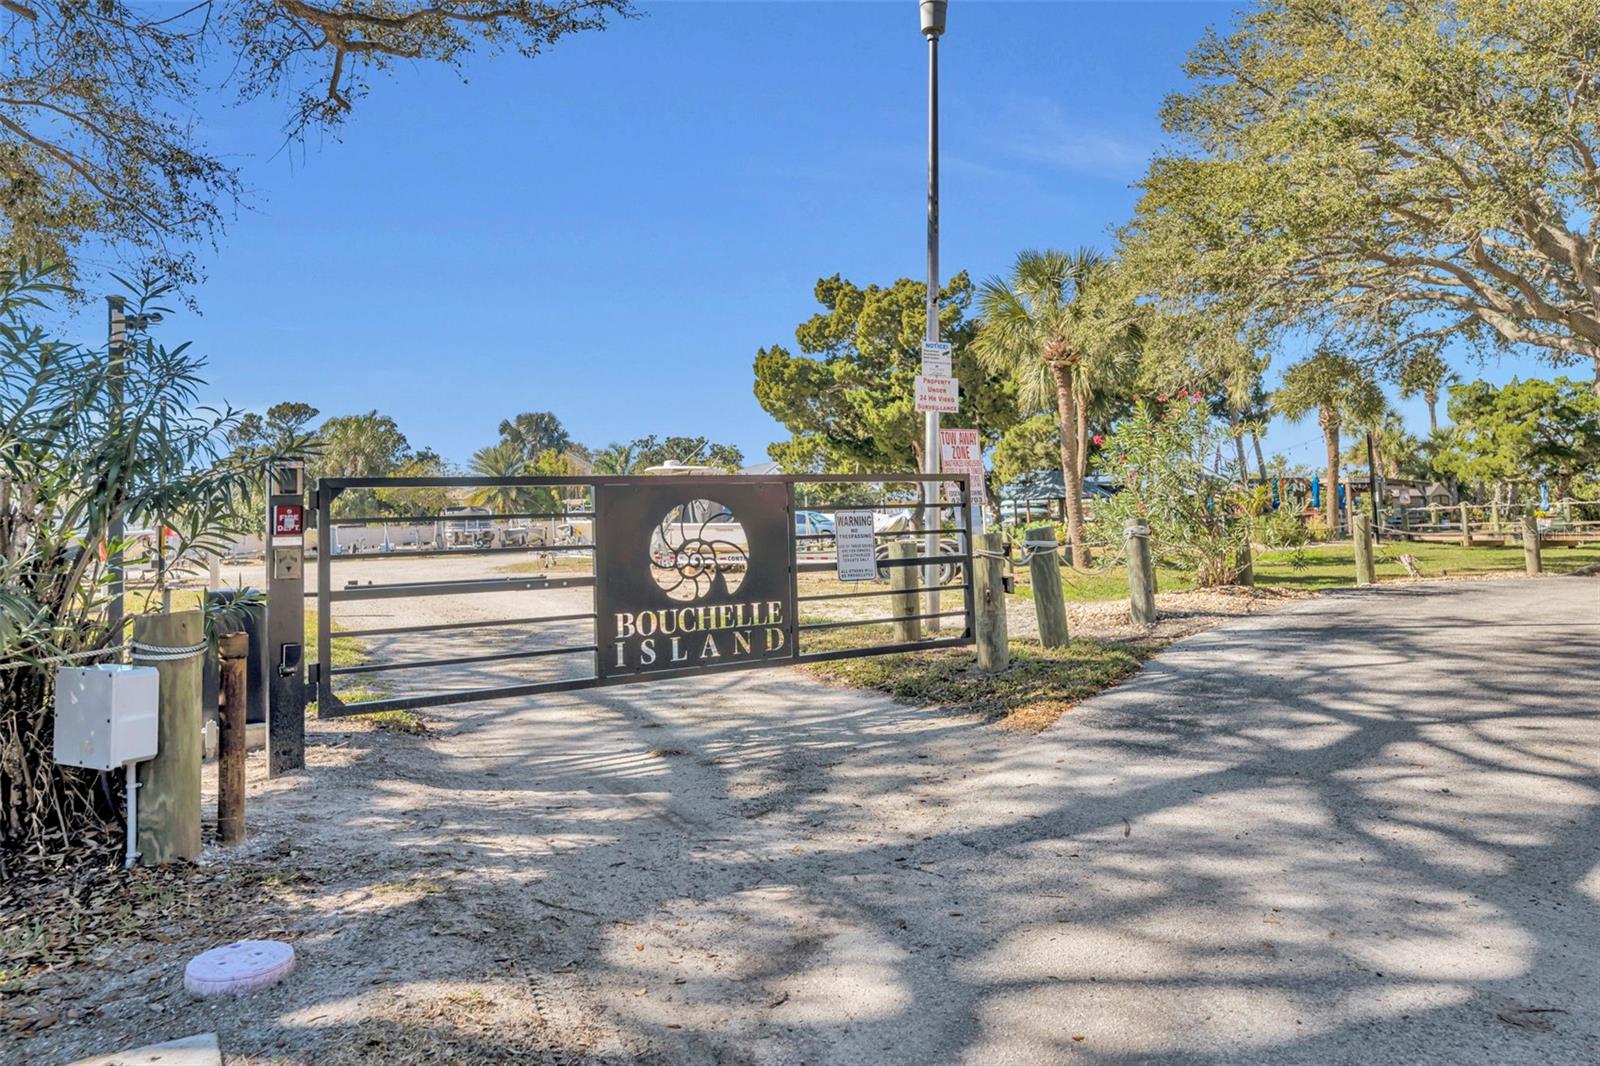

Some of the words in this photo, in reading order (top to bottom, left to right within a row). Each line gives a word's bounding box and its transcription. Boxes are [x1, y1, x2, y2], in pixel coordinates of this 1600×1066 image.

[923, 377, 951, 385] PROPERTY
[917, 403, 957, 411] SURVEILLANCE
[941, 431, 957, 446] TOW
[959, 431, 977, 446] AWAY
[951, 445, 970, 460] ZONE
[837, 515, 872, 527] WARNING
[614, 601, 784, 639] BOUCHELLE
[614, 627, 785, 668] ISLAND
